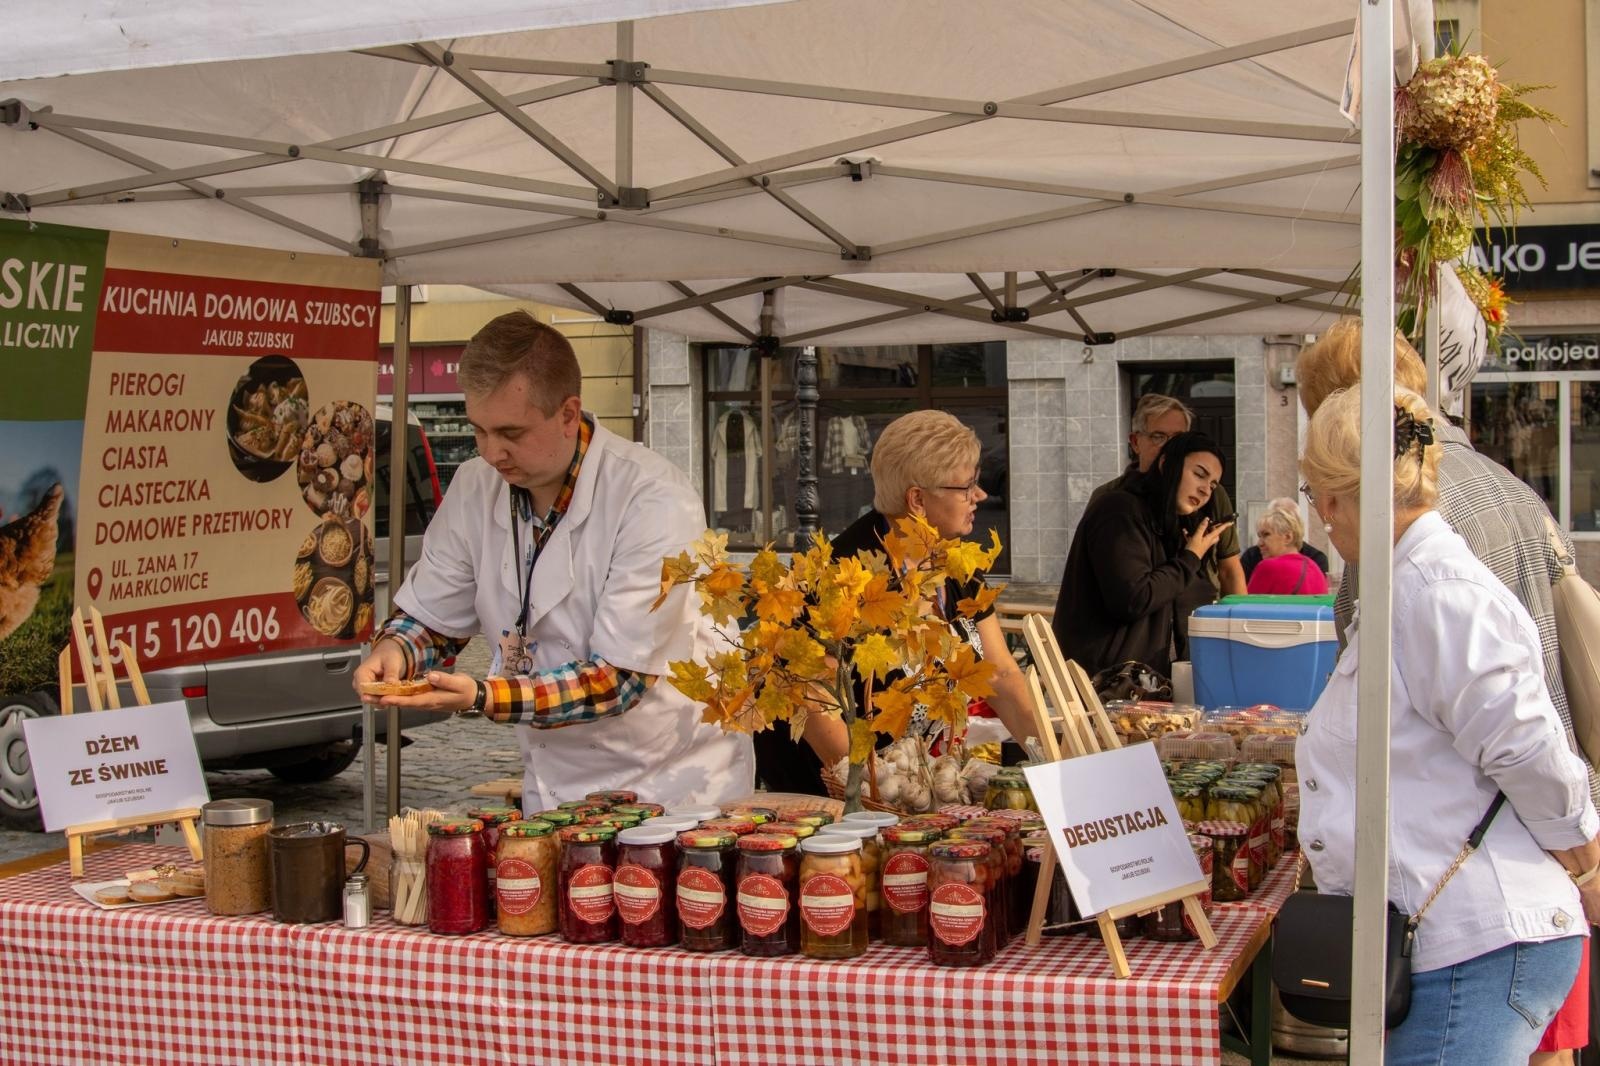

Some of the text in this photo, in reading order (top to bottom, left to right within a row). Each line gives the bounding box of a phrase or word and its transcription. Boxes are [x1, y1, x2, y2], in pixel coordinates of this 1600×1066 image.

[0, 258, 88, 312] SKIE
[103, 285, 376, 328] KUCHNIA DOMOWA SZUBSCY
[0, 321, 80, 349] LICZNY
[202, 329, 294, 349] JAKUB SZUBSKI
[1082, 347, 1094, 364] 2
[1506, 342, 1599, 365] pakojea
[110, 372, 185, 396] PIEROGI
[1280, 396, 1288, 406] 3
[105, 408, 215, 434] MAKARONY
[102, 445, 168, 471] CIASTA
[98, 479, 210, 508] CIASTECZKA
[95, 508, 293, 545] DOMOWE PRZETWORY
[111, 552, 198, 578] UL. ZANA 17
[109, 572, 209, 600] MARKLOWICE
[171, 612, 221, 652] 120
[230, 606, 280, 643] 406
[85, 734, 140, 756] DŻEM
[68, 758, 169, 786] ZE ŚWINIE
[1062, 806, 1168, 849] DEGUSTACJA
